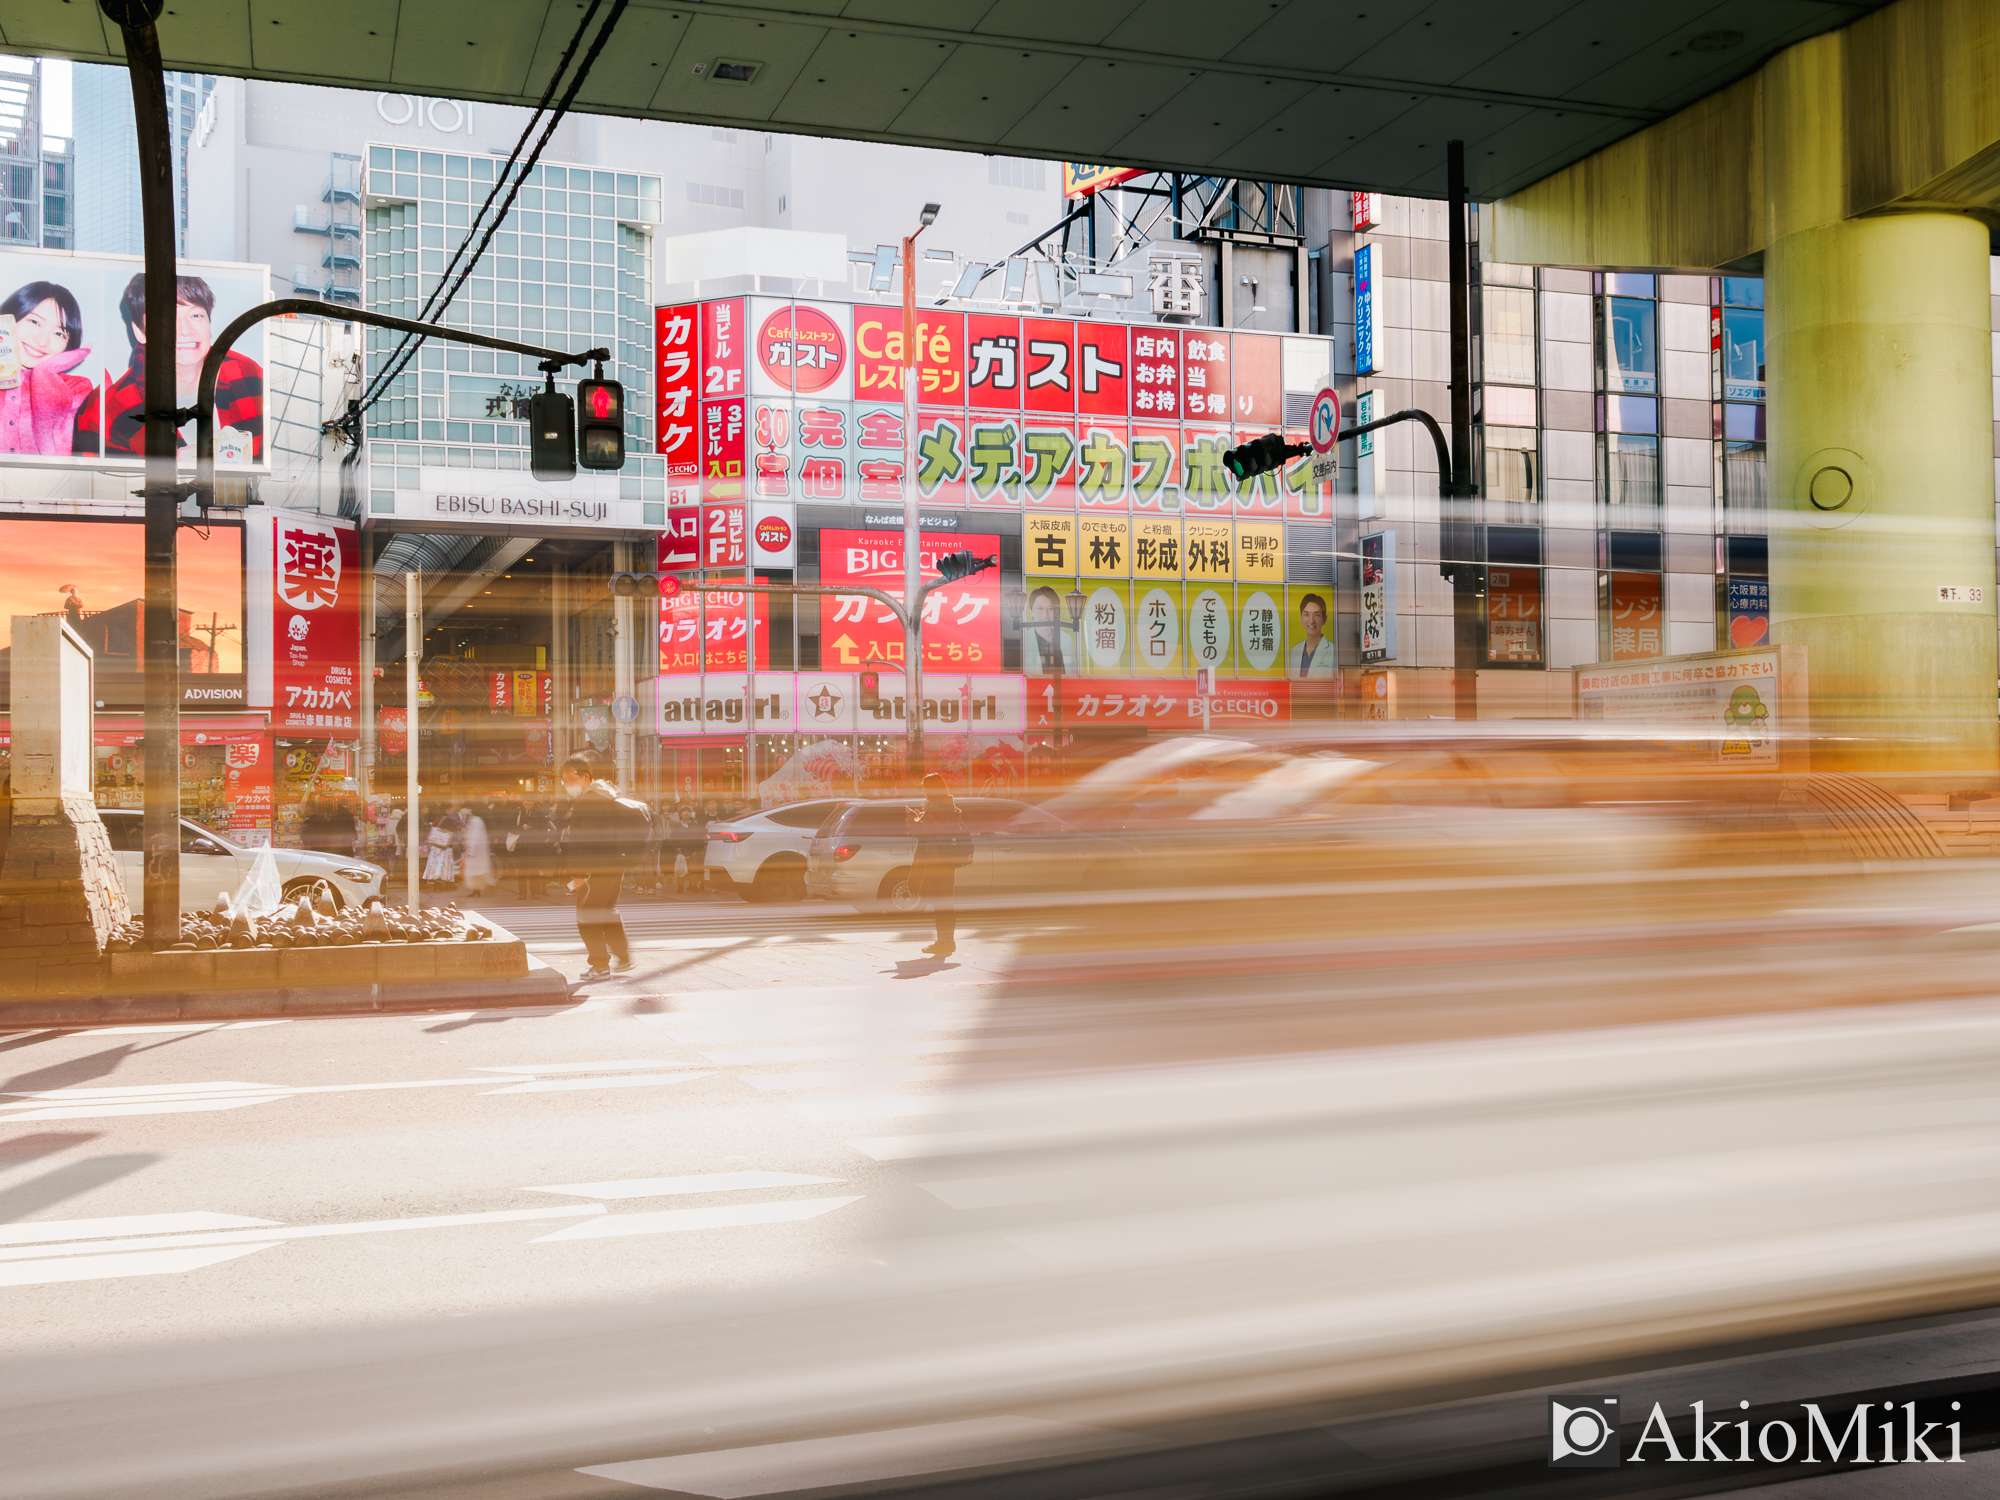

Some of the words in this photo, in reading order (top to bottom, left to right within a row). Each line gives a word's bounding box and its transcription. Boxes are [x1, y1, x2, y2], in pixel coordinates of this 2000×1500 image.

[715, 303, 731, 359] 当ビル
[856, 320, 951, 364] Café
[1364, 292, 1372, 367] ゆうメンタル
[768, 341, 838, 370] ガスト
[969, 335, 1122, 394] ガスト
[500, 382, 541, 397] なんば
[662, 315, 693, 453] カラオケ
[705, 365, 741, 394] 2F
[707, 406, 722, 456] 当ビル
[727, 405, 742, 442] 3F
[798, 407, 905, 451] 完全
[707, 459, 741, 480] 入口
[798, 455, 905, 502] 個室
[1313, 459, 1337, 479] 交差点内
[436, 495, 495, 513] EBISU
[669, 488, 687, 505] B1
[661, 517, 697, 540] 入口
[865, 514, 957, 527] なんば戎橋チビジョン
[709, 509, 726, 563] 2F
[729, 508, 744, 562] 当ビル
[759, 530, 788, 543] ガスト
[858, 538, 894, 546] Karaoke
[898, 539, 962, 548] Etainment
[1241, 535, 1279, 551] 日帰り
[284, 528, 336, 605] 薬
[847, 548, 897, 574] BIG
[1246, 553, 1275, 568] 手術
[1492, 574, 1508, 586] 2階
[1730, 584, 1768, 597] 大阪難波
[832, 590, 989, 625] カラオケ
[1491, 593, 1536, 619] オレ
[1615, 597, 1658, 621] ンジ
[1730, 598, 1768, 610] 心療内科
[1969, 588, 1981, 601] 33
[660, 616, 761, 643] カラオケ
[1094, 603, 1116, 650] 粉瘤
[1148, 599, 1167, 656] ホクロ
[1202, 598, 1217, 660] できもの
[1249, 609, 1260, 650] ワキガ
[1260, 609, 1274, 652] 静脈瘤
[1494, 625, 1535, 638] 処方せん
[865, 640, 983, 662] 入口こちら
[1614, 627, 1659, 654] 薬局
[325, 675, 352, 685] COSMETIC
[331, 666, 346, 676] DRUG
[347, 667, 352, 676] &
[285, 685, 352, 710] アカカベ
[872, 684, 997, 723] atagirl
[1077, 694, 1177, 717] カラオケ
[1188, 698, 1223, 717] BG
[1227, 698, 1279, 717] ECHO
[235, 795, 270, 803] アカカベ
